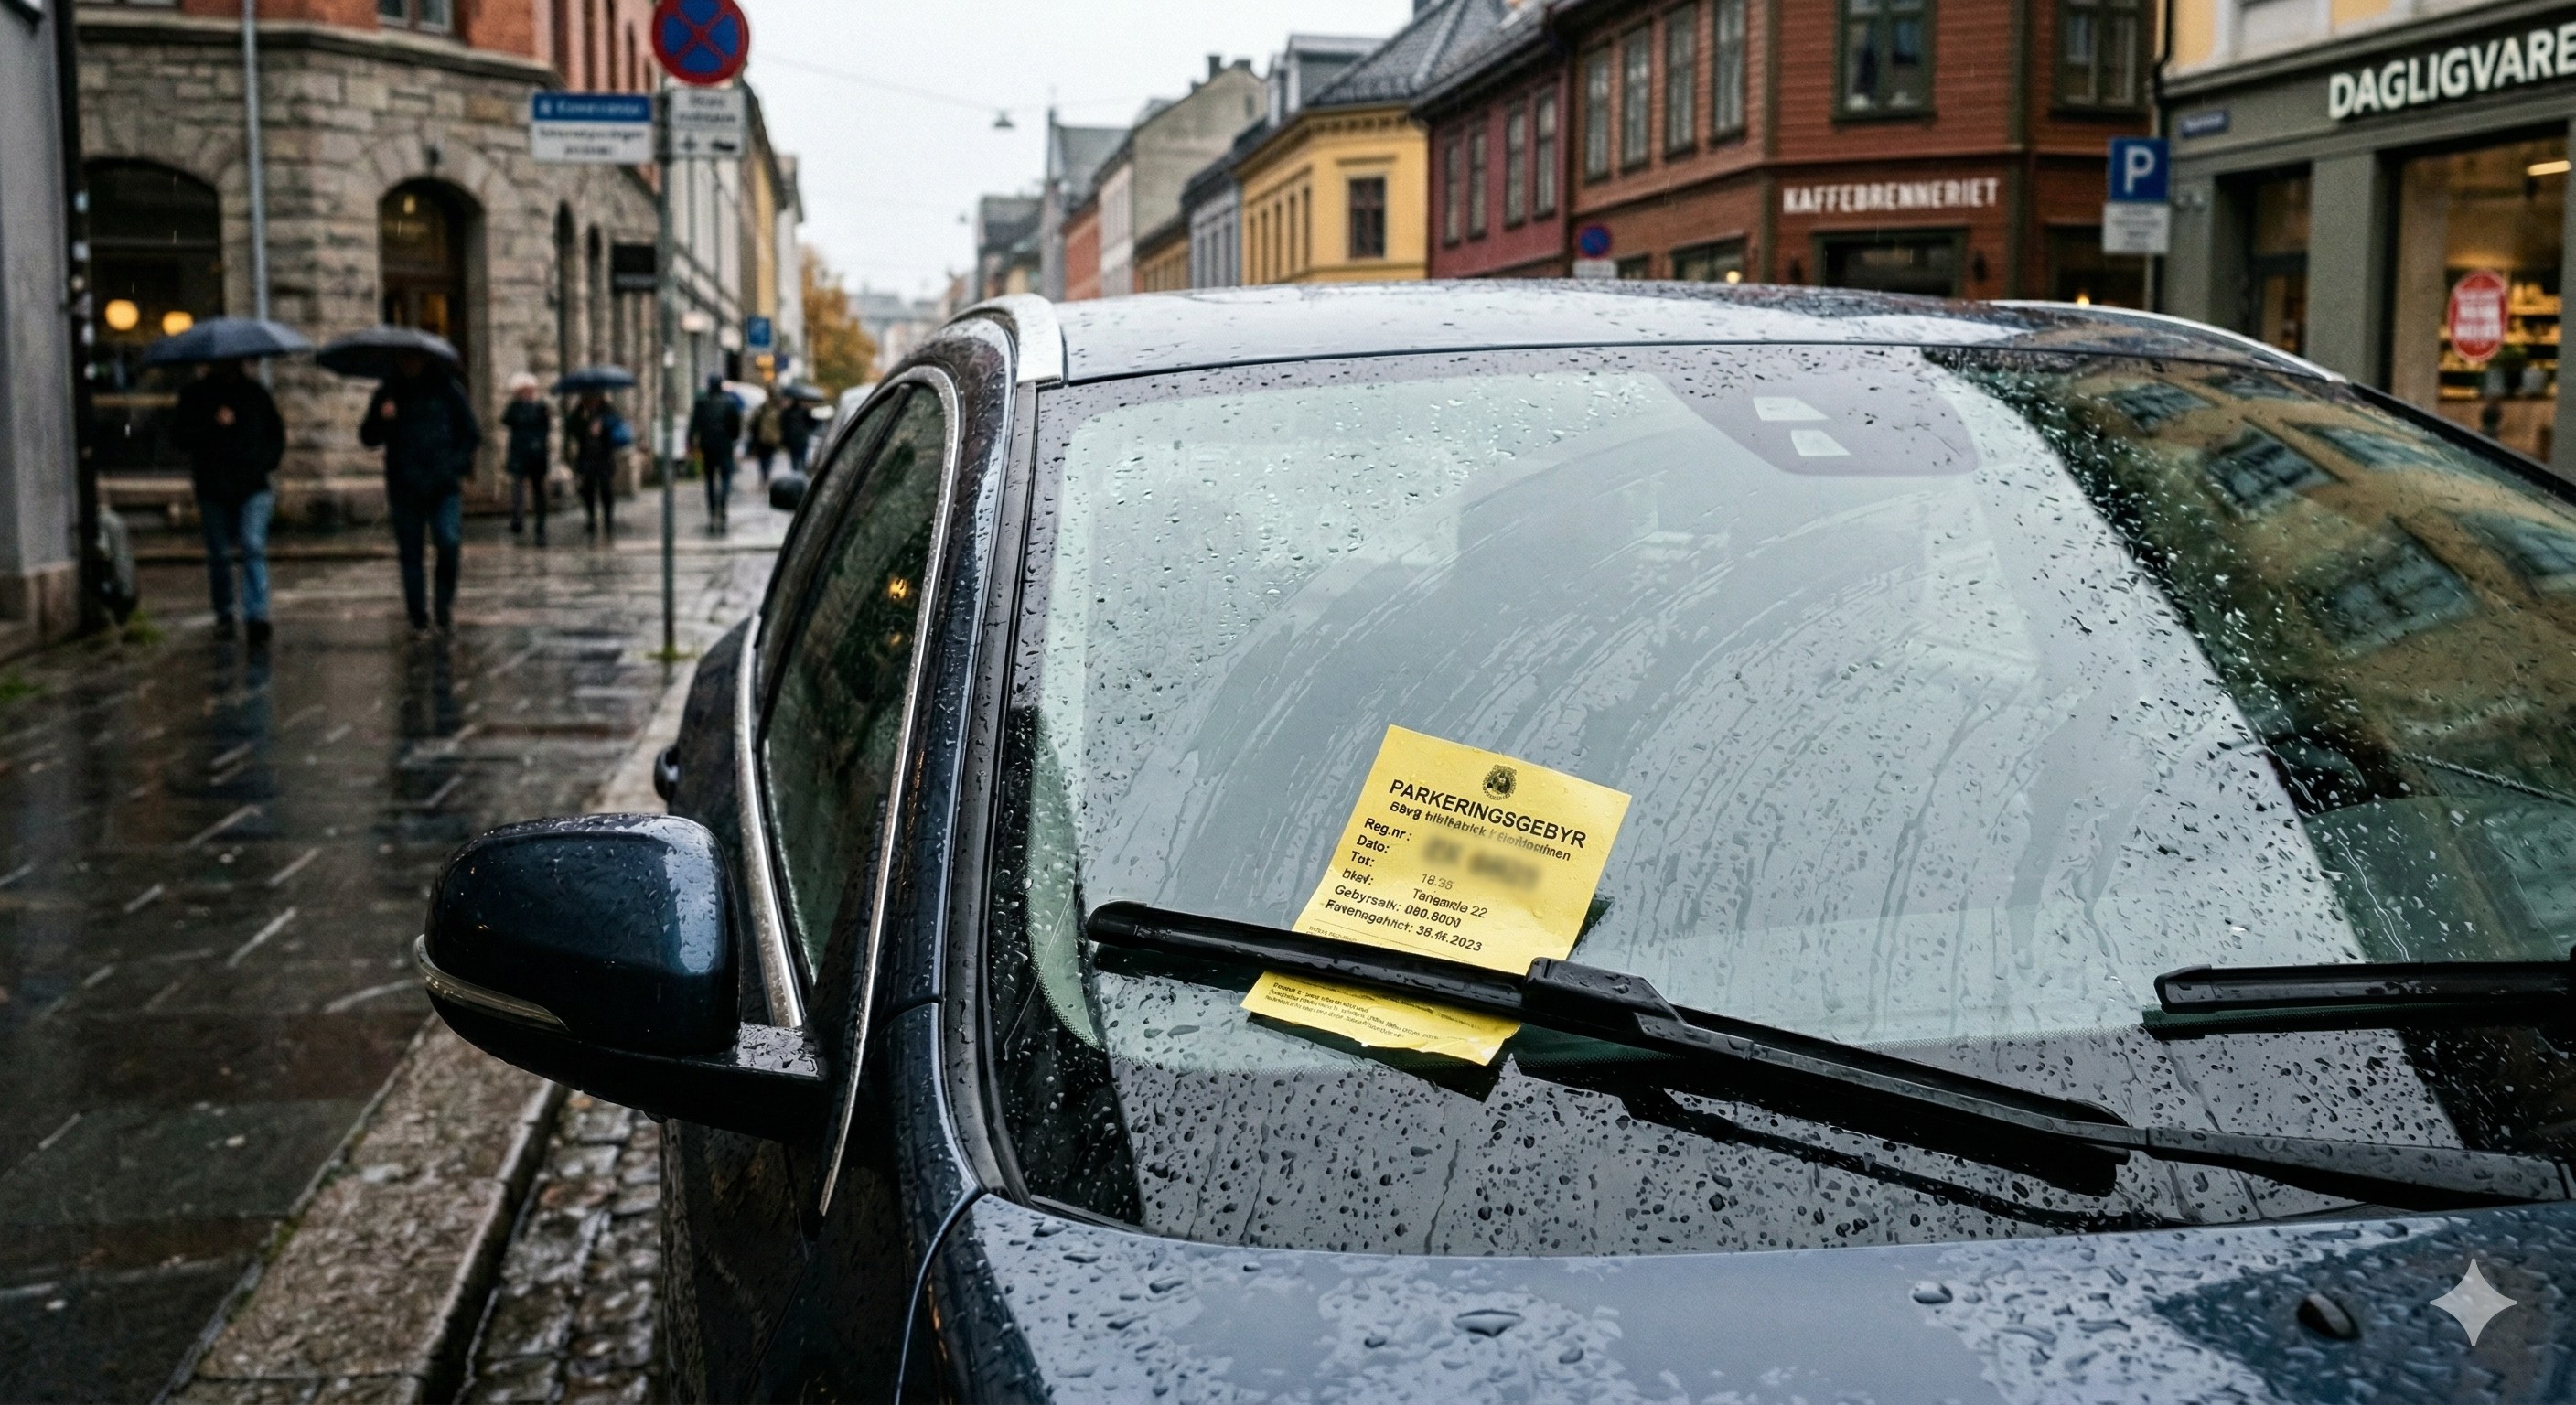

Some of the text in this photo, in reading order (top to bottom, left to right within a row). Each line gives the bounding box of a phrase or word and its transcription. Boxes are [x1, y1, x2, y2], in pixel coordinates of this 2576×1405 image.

[2328, 22, 2576, 120] DAGLIGVARE
[2123, 145, 2155, 194] P
[1784, 177, 1999, 214] KAFFEBRENNERIET
[1389, 779, 1586, 848] PARKERINGSGEBYR
[1356, 834, 1390, 853] Dato:
[1470, 906, 1487, 918] 22
